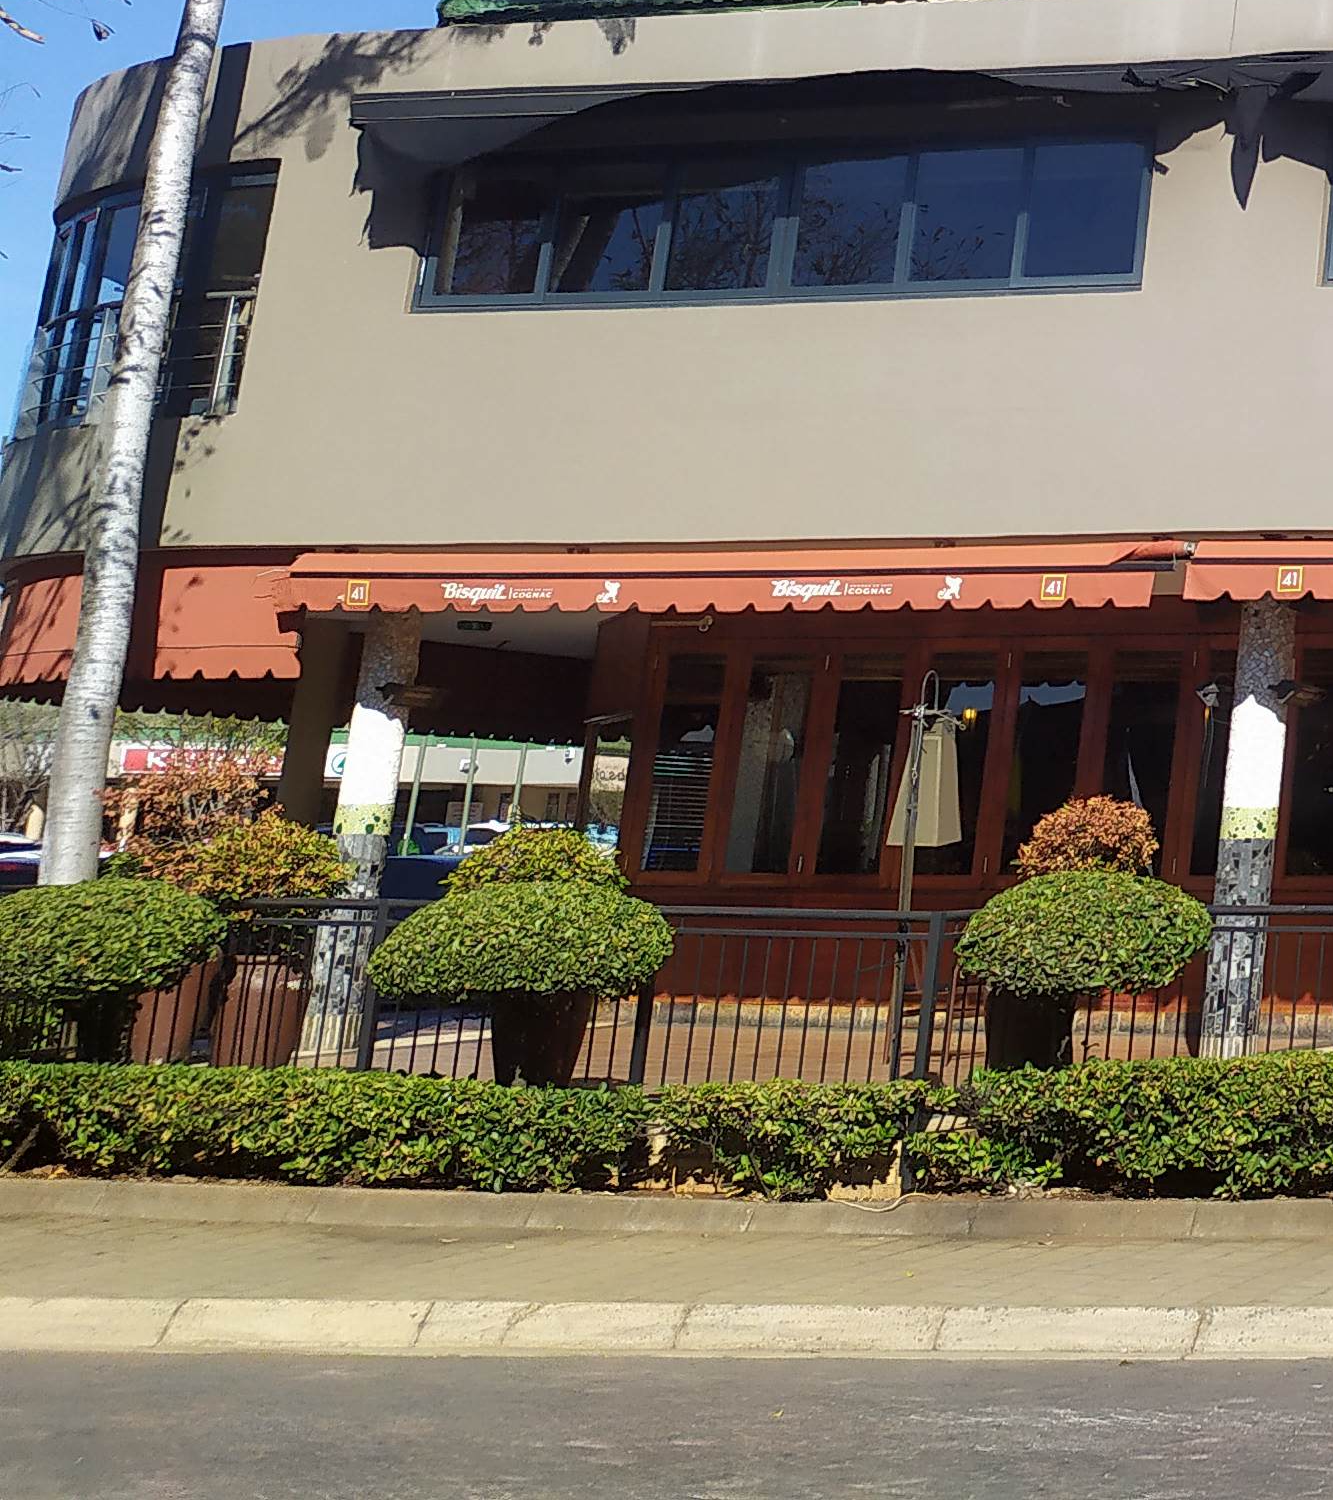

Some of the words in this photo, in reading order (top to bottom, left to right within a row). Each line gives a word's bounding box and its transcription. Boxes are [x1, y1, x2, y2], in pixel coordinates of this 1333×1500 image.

[1281, 570, 1298, 587] 41
[351, 586, 364, 600] 41
[441, 582, 507, 606] Bisquit
[512, 591, 553, 599] COGNAC
[771, 579, 843, 604] Bisquit
[847, 587, 893, 595] COGNAC
[1045, 579, 1061, 596] 41
